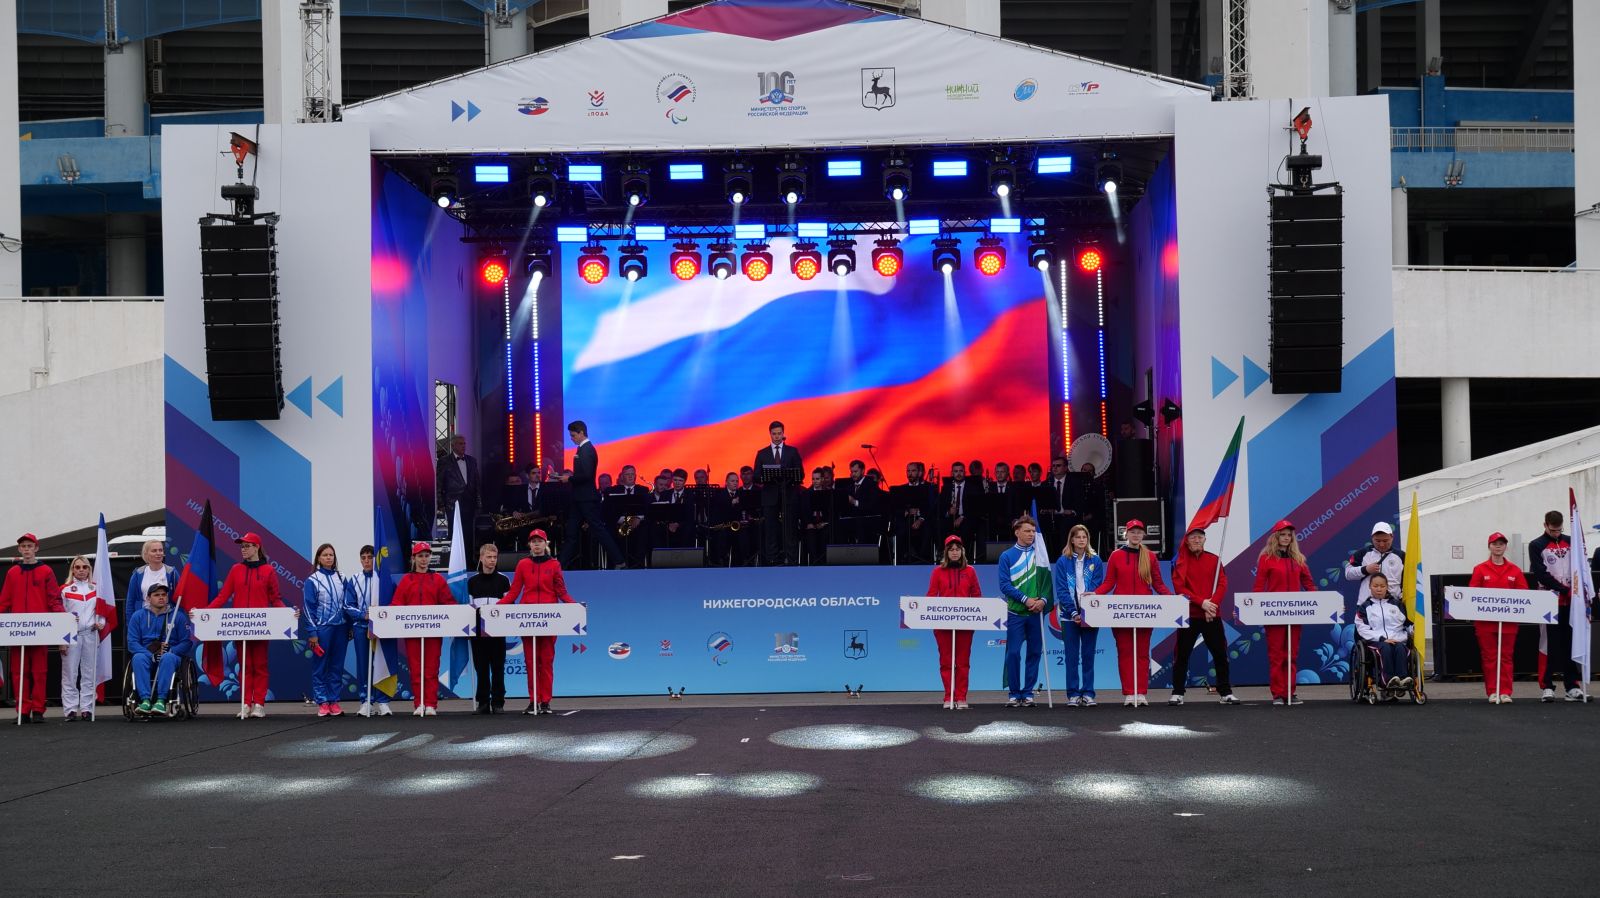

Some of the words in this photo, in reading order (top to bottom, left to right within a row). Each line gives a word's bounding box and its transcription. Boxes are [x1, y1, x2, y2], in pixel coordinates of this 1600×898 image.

[1334, 474, 1380, 511] ОБЛАСТЬ
[270, 560, 305, 591] ОБЛАС
[703, 597, 817, 609] НИЖЕГОРОДСКАЯ
[819, 596, 880, 607] ОБЛАСТЬ
[1260, 600, 1319, 609] РЕСПУБЛИКА
[1471, 596, 1532, 606] РЕСПУБЛИКА
[926, 605, 982, 613] РЕСПУБЛИКА
[1107, 603, 1163, 611] РЕСПУБЛИКА
[1477, 605, 1511, 614] МАРИЙ
[1512, 607, 1526, 615] ЭЛ
[220, 612, 268, 620] ДОНЕЦКАЯ
[395, 613, 450, 621] РЕСПУБЛИКА
[505, 612, 562, 620] РЕСПУБЛИКА
[1112, 612, 1157, 620] ДАГЕСТАН
[1263, 609, 1316, 618] КАЛМЫКИЯ
[919, 614, 989, 623] БАШКОРТОСТАН
[0, 620, 52, 628] ЕСПУБЛИКА
[220, 620, 268, 629] НАРОДНАЯ
[404, 622, 442, 630] БУРЯТИЯ
[518, 620, 549, 629] АЛТАЙ
[216, 629, 272, 637] РЕСПУБЛИКА
